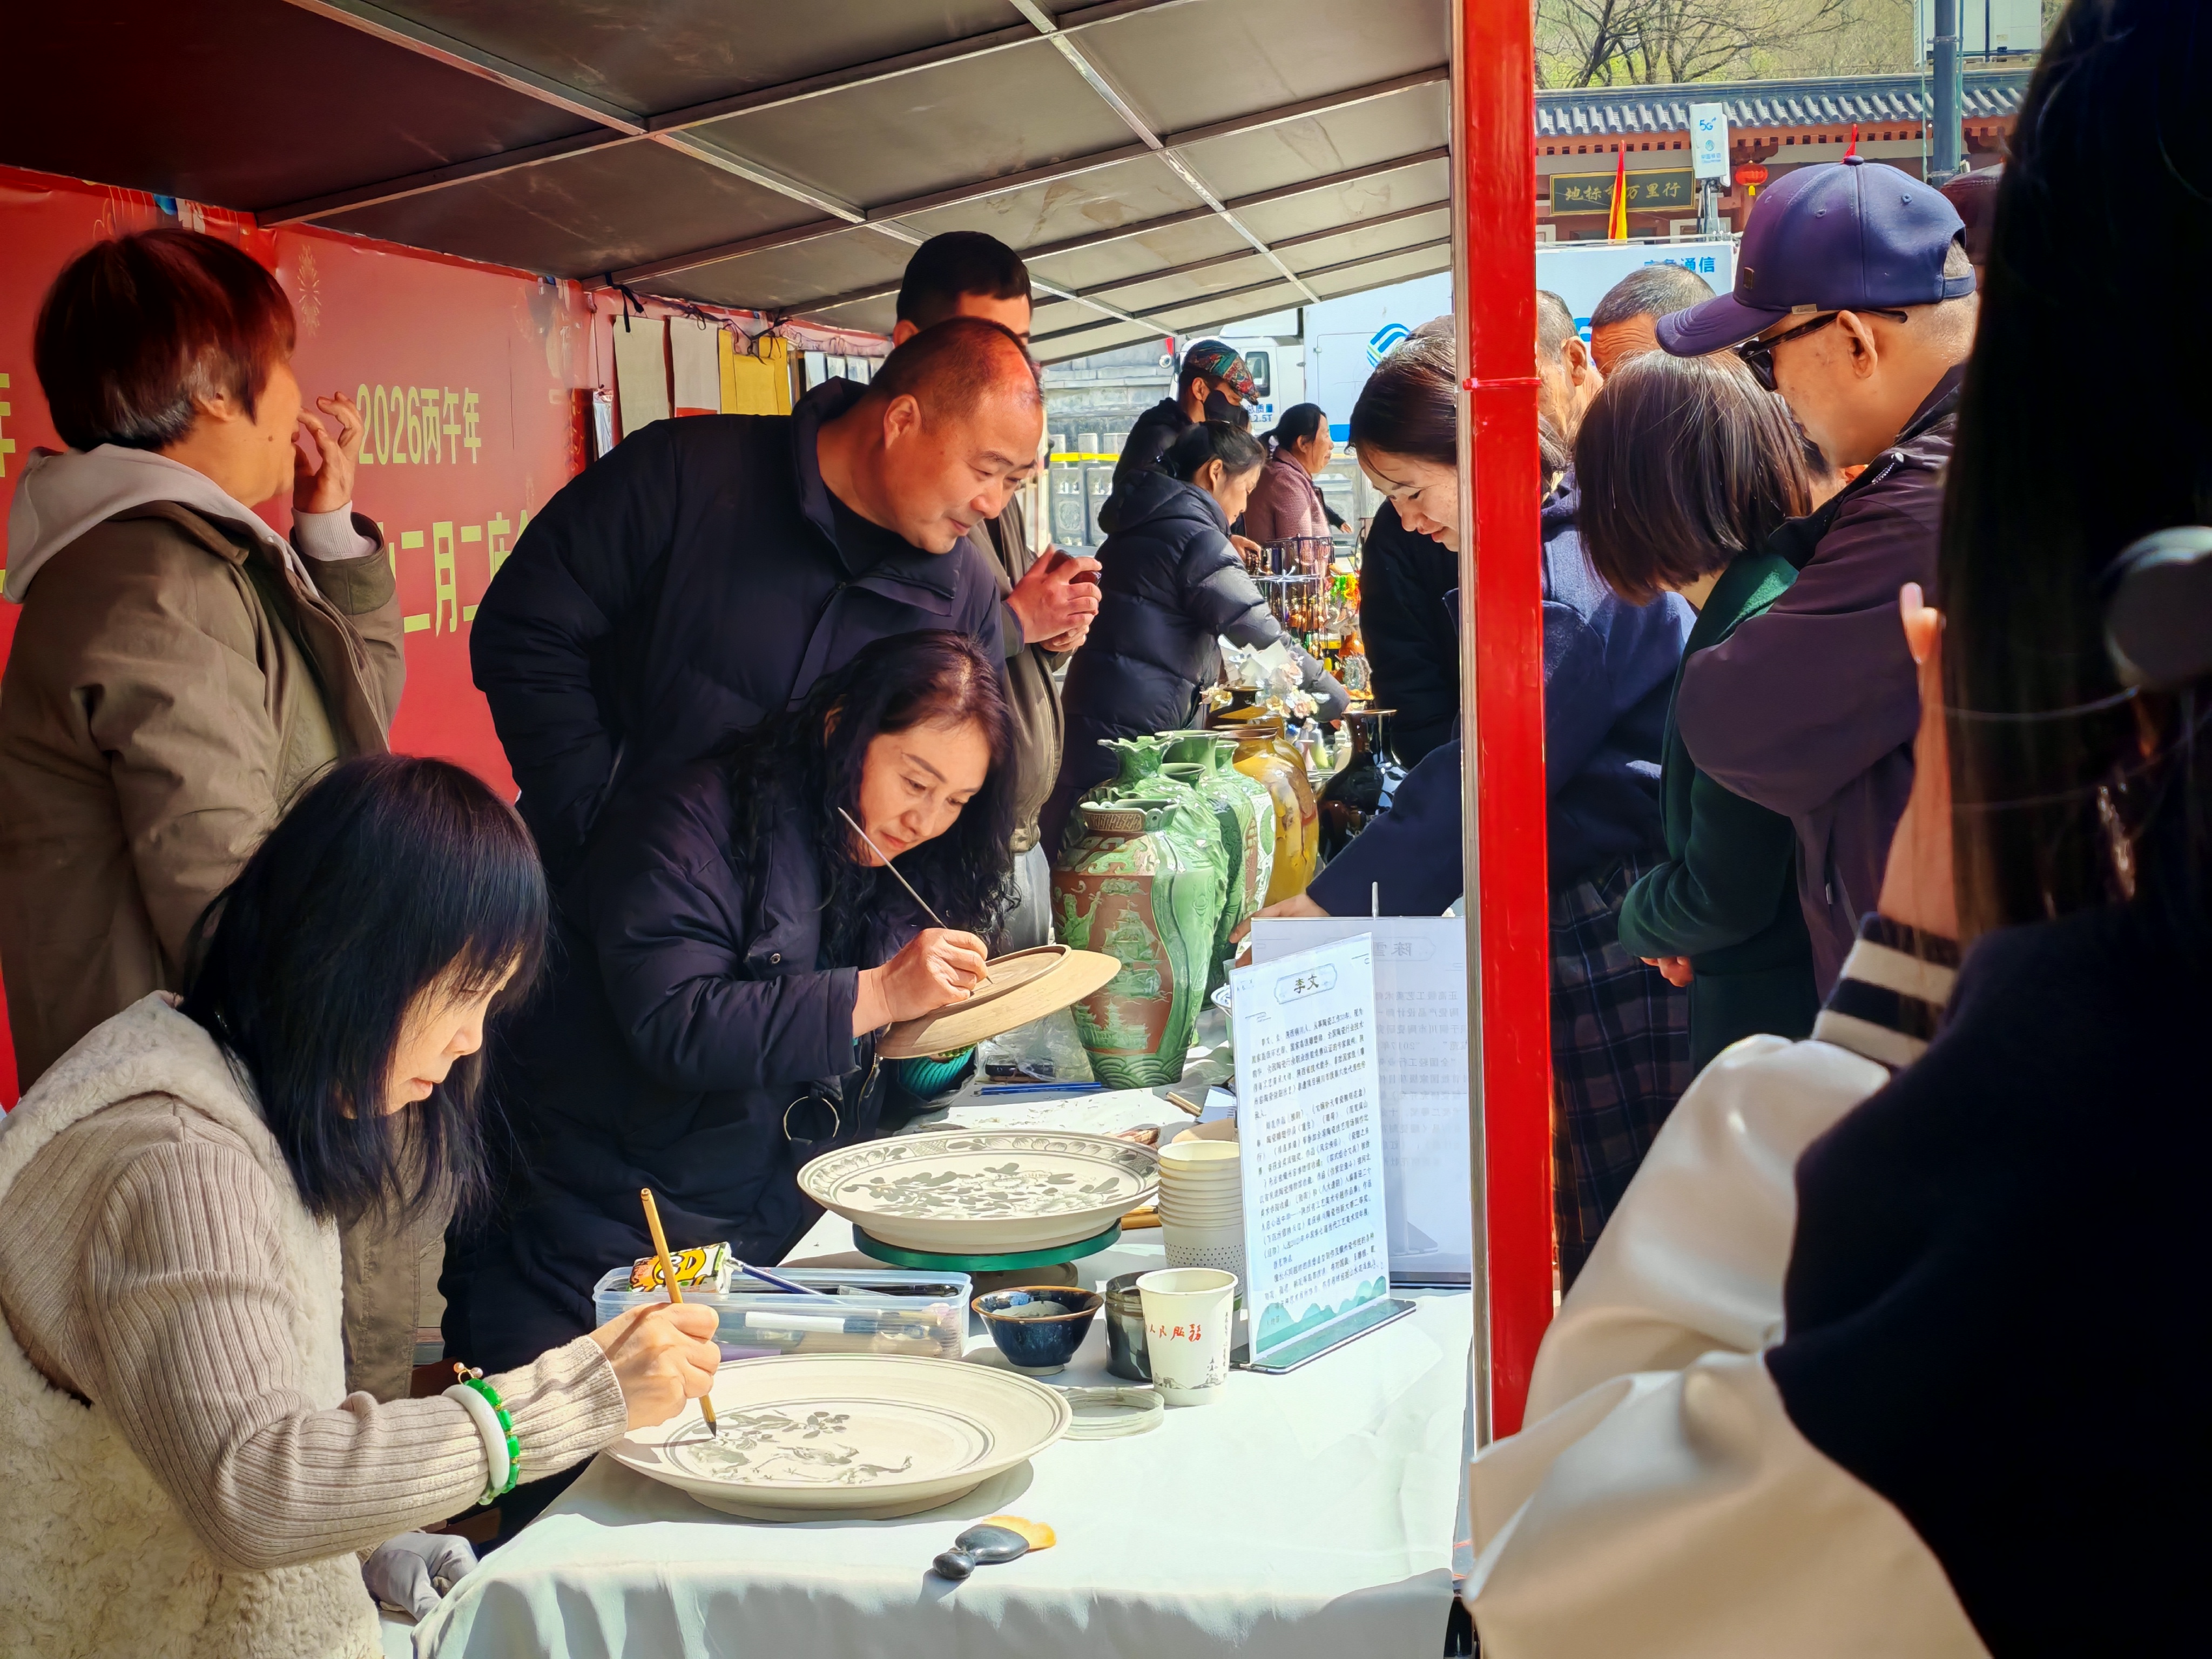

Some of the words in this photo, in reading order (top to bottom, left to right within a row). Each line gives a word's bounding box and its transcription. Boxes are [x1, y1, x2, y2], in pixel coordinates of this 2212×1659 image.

[356, 384, 482, 465] 2026丙午年
[1293, 972, 1319, 995] 李文
